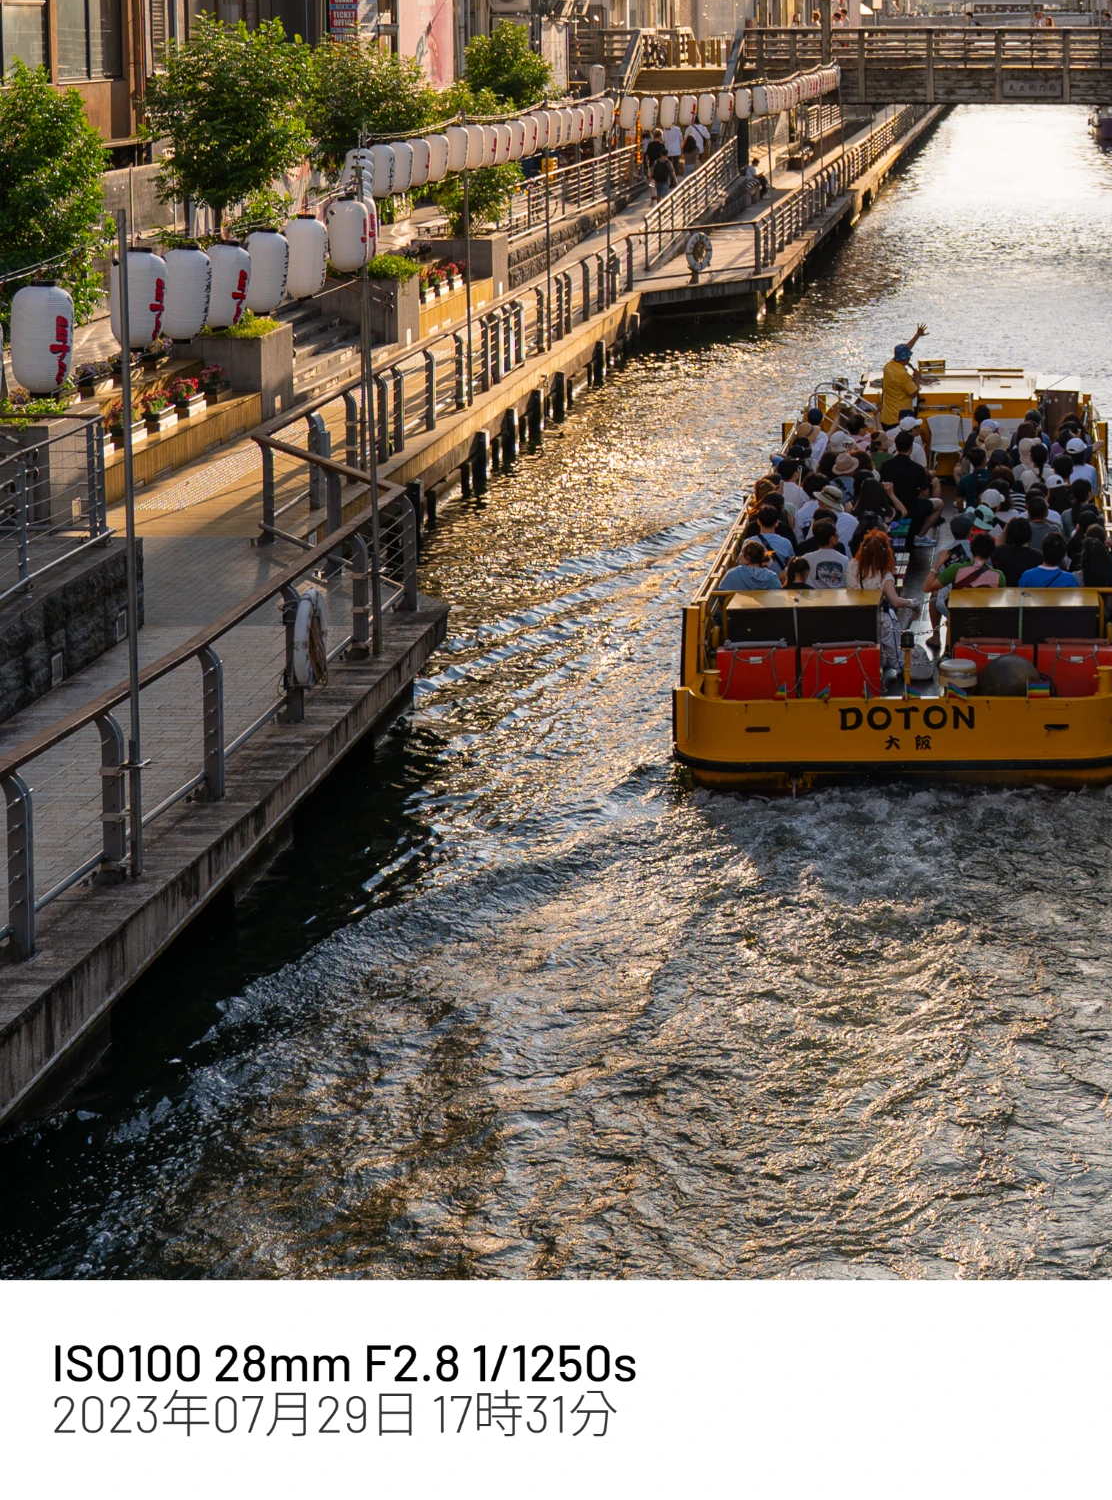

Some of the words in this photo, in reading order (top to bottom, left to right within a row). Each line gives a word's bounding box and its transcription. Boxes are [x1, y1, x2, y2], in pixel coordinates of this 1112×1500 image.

[332, 11, 355, 19] TICKET
[838, 705, 976, 731] DOTON
[885, 735, 932, 750] 大阪
